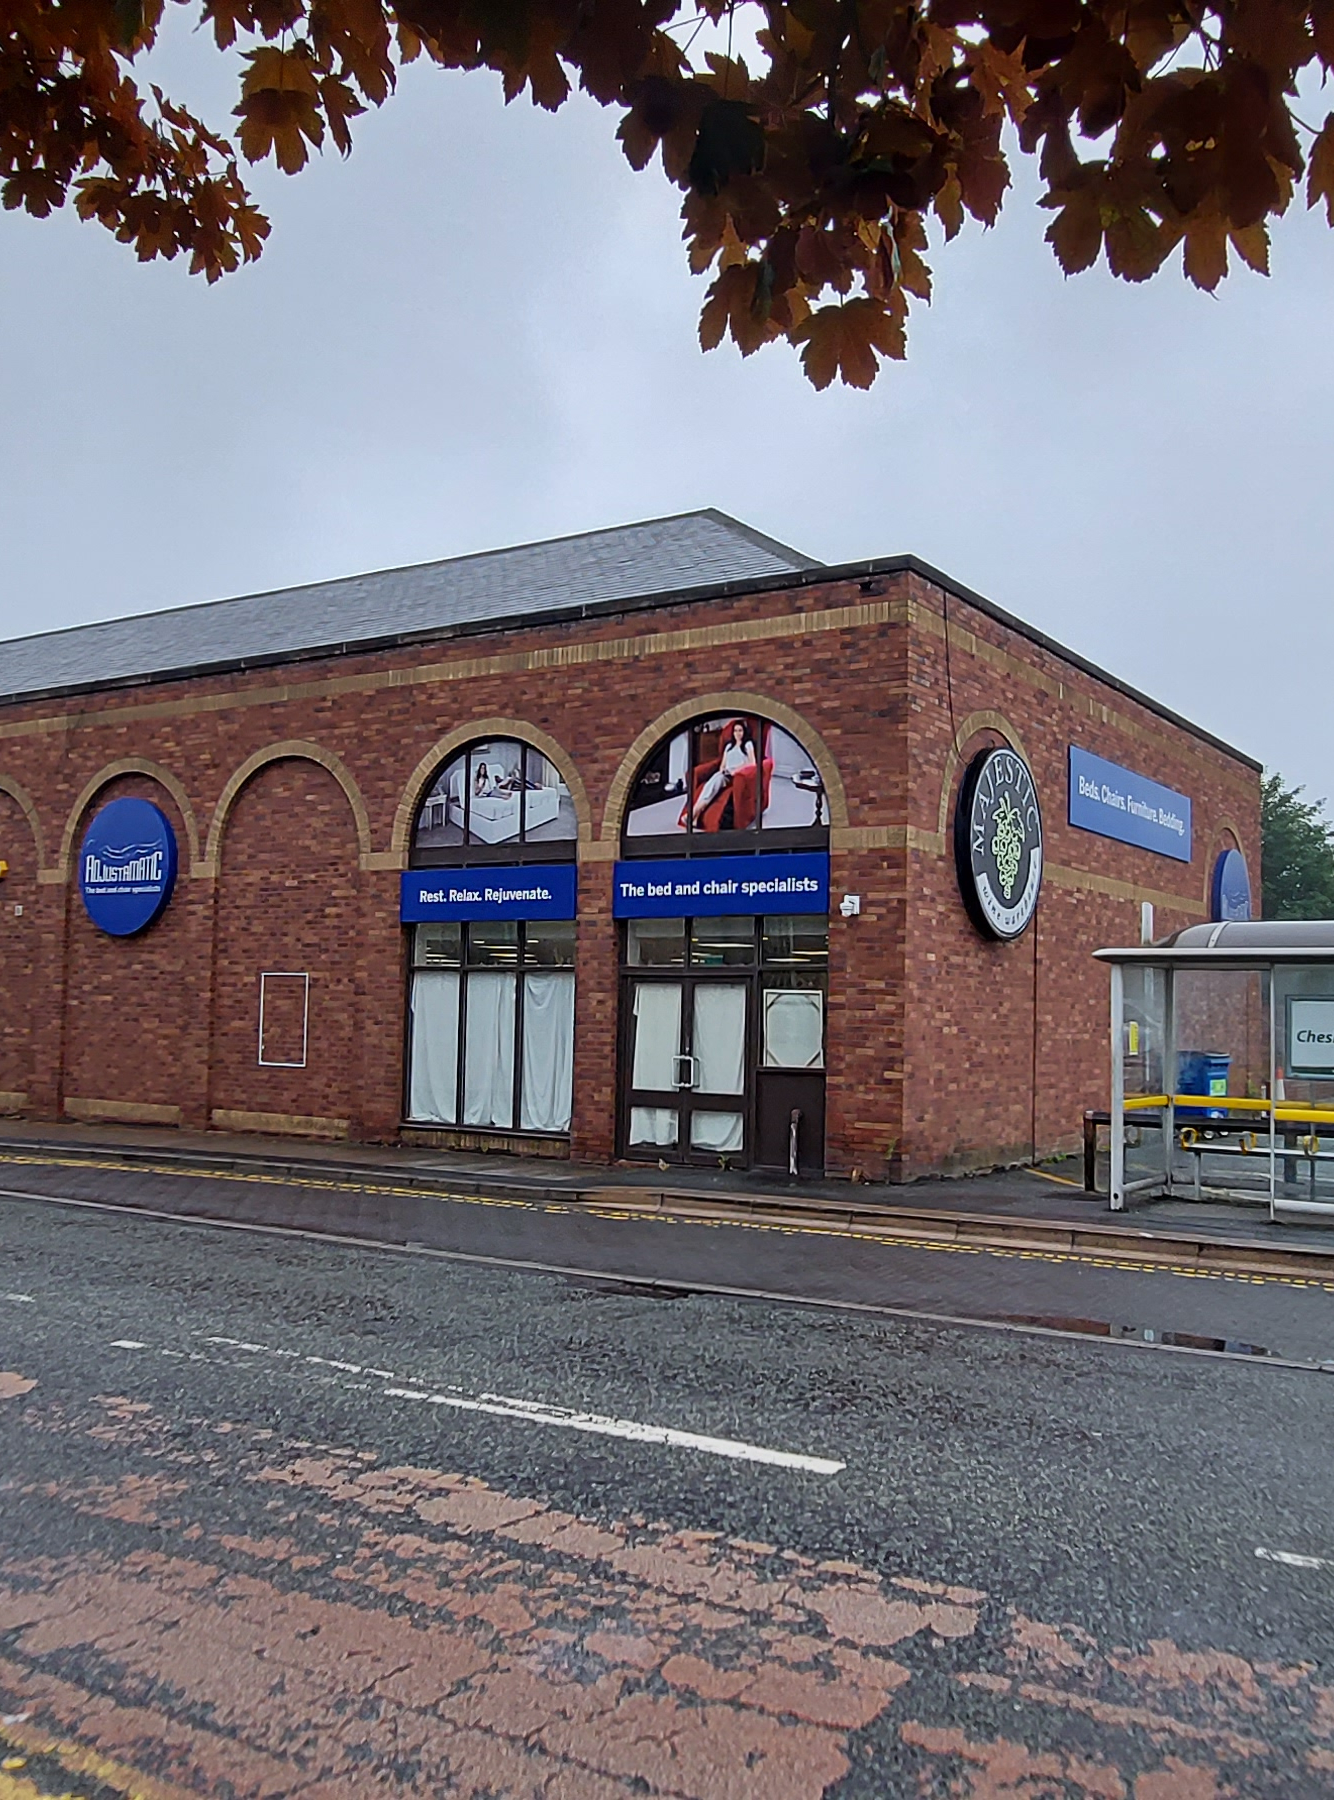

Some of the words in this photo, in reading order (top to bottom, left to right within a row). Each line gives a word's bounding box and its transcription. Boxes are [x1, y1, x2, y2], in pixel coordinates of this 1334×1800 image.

[972, 755, 1039, 856] MAJESTIC
[1078, 775, 1101, 801] Beds.
[1101, 784, 1127, 811] Chairs.
[85, 851, 163, 883] ADJUSTAMATIC
[419, 889, 447, 903] Rest.
[449, 888, 482, 902] Relax.
[484, 886, 552, 904] Rejuvenate.
[620, 883, 645, 898] The
[647, 882, 672, 897] bed
[674, 880, 700, 896] and
[703, 879, 738, 895] chair
[741, 877, 818, 897] specialists
